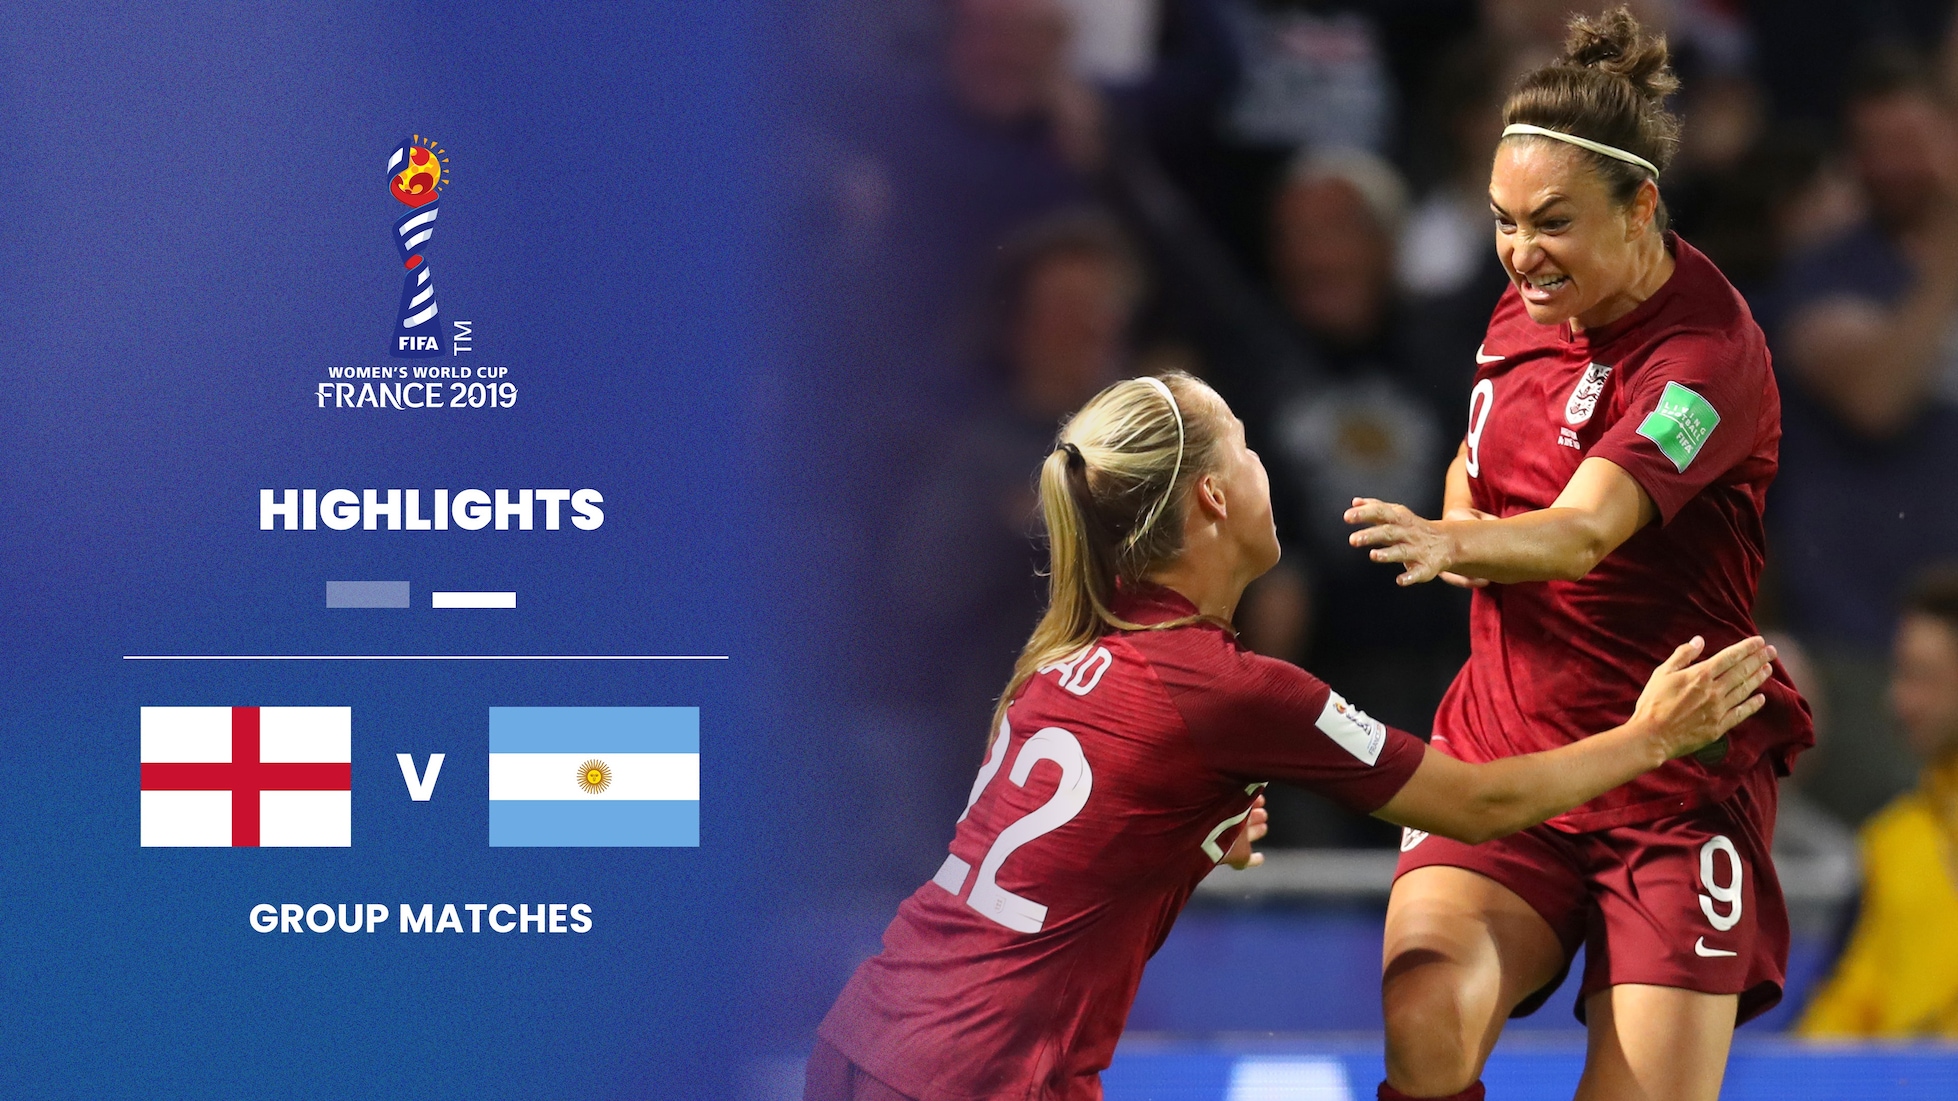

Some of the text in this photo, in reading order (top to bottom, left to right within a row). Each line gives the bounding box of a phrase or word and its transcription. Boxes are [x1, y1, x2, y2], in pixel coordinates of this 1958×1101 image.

[1466, 378, 1494, 478] 9
[1664, 401, 1707, 436] LIVING
[1676, 431, 1694, 454] FIFA
[1037, 645, 1112, 696] AD
[1698, 835, 1743, 931] 9
